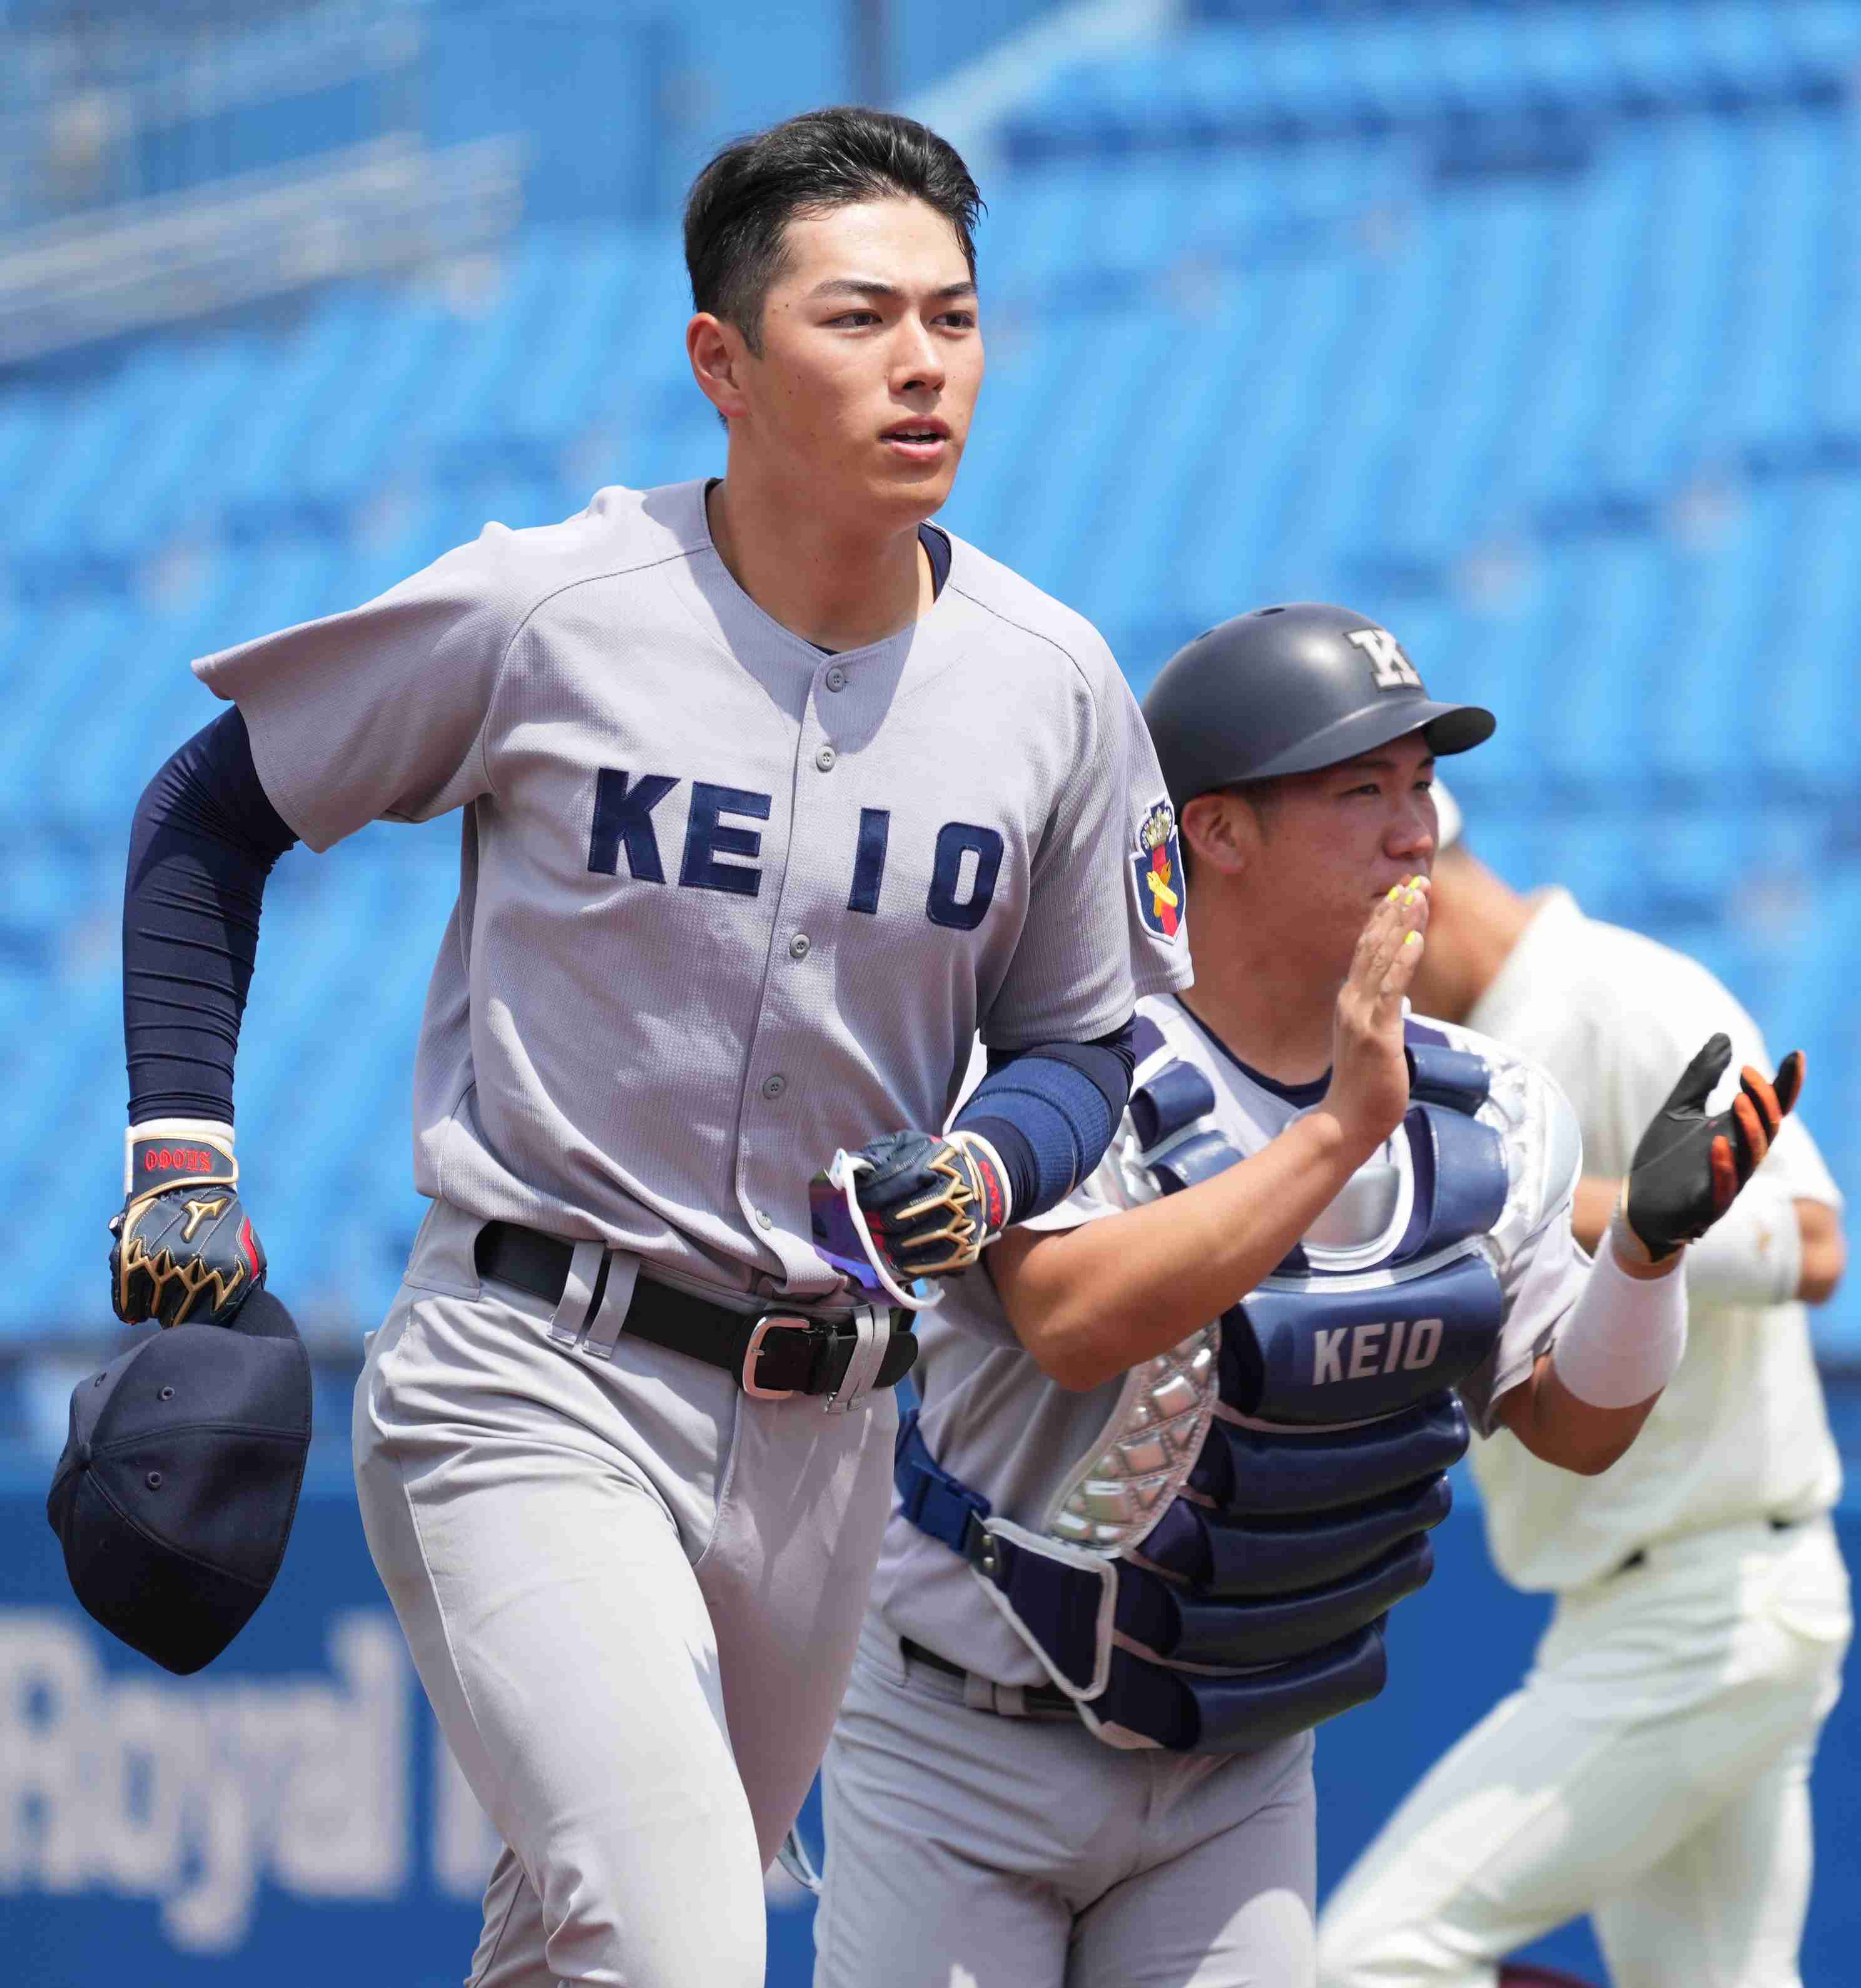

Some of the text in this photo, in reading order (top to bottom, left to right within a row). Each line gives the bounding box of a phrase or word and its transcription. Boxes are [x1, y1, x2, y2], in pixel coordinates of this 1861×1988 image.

[1344, 628, 1423, 688] K
[587, 768, 1005, 931] KEIO
[1312, 1319, 1443, 1386] KEIO
[0, 1615, 408, 1948] Royal
